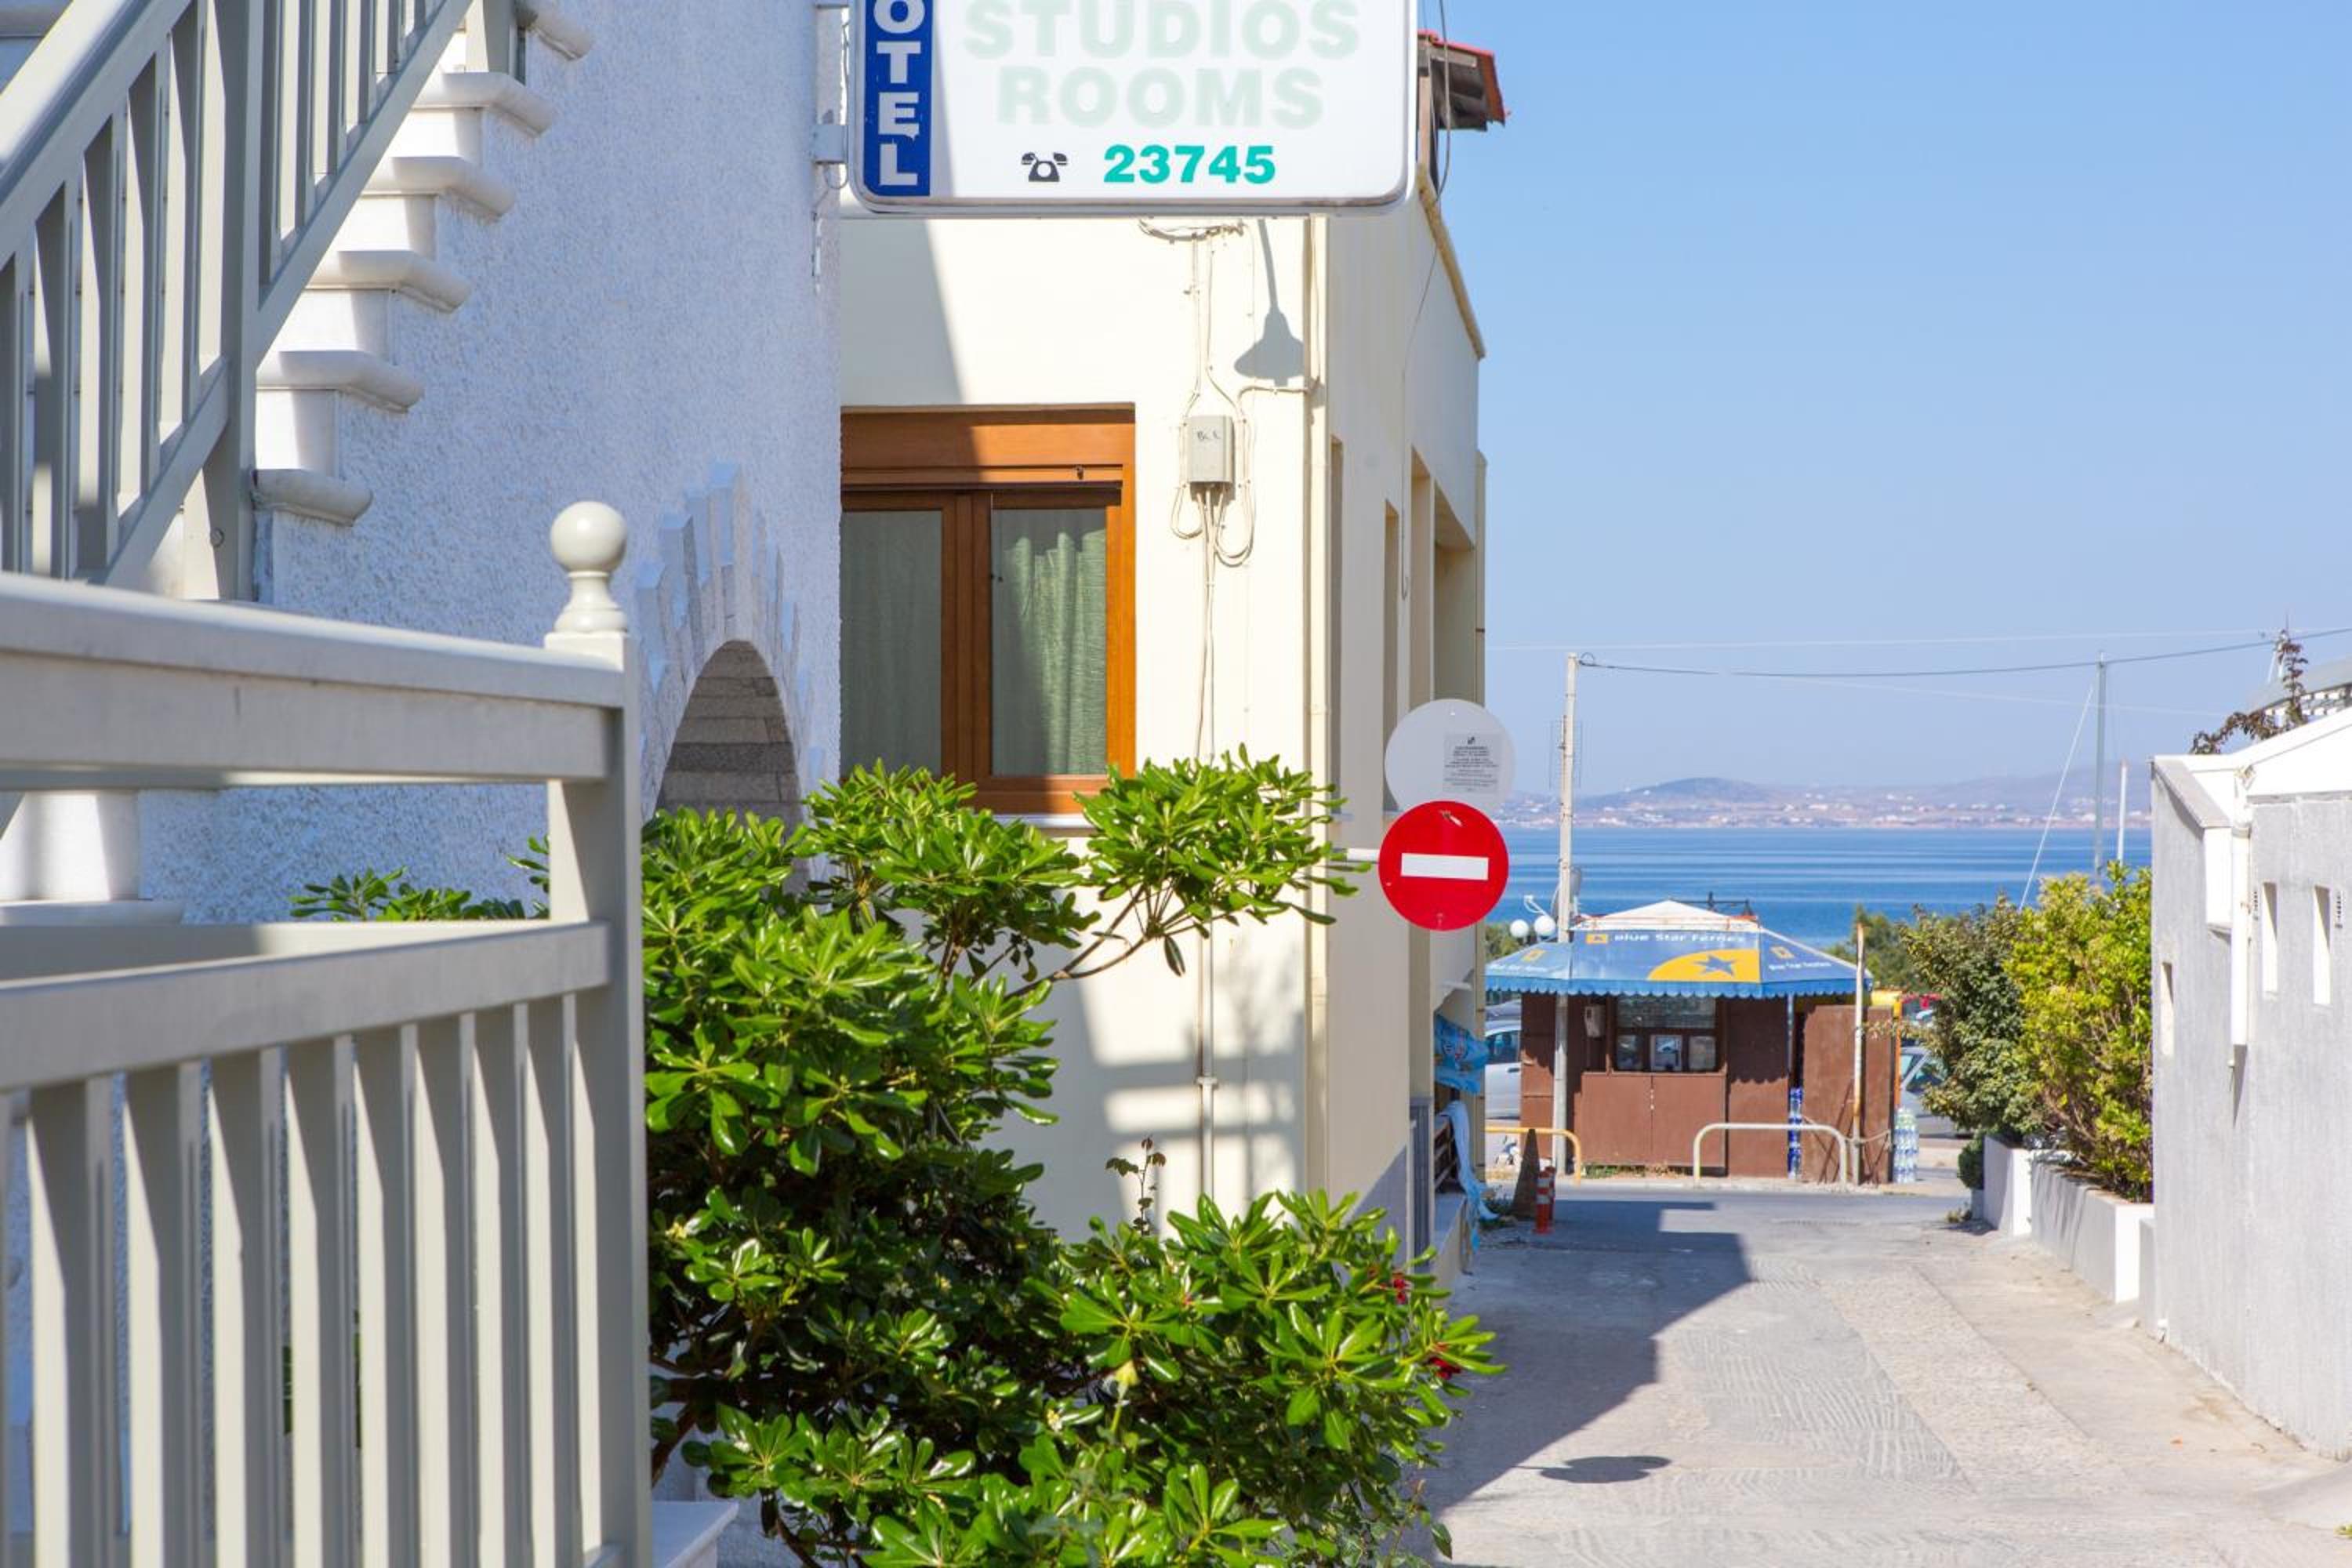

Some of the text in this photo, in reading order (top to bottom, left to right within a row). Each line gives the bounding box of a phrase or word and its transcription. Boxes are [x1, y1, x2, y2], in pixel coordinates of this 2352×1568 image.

[964, 0, 1360, 60] STUDIOS
[996, 66, 1324, 129] ROOMS
[1104, 144, 1276, 184] 23745
[1655, 933, 1686, 942] Star
